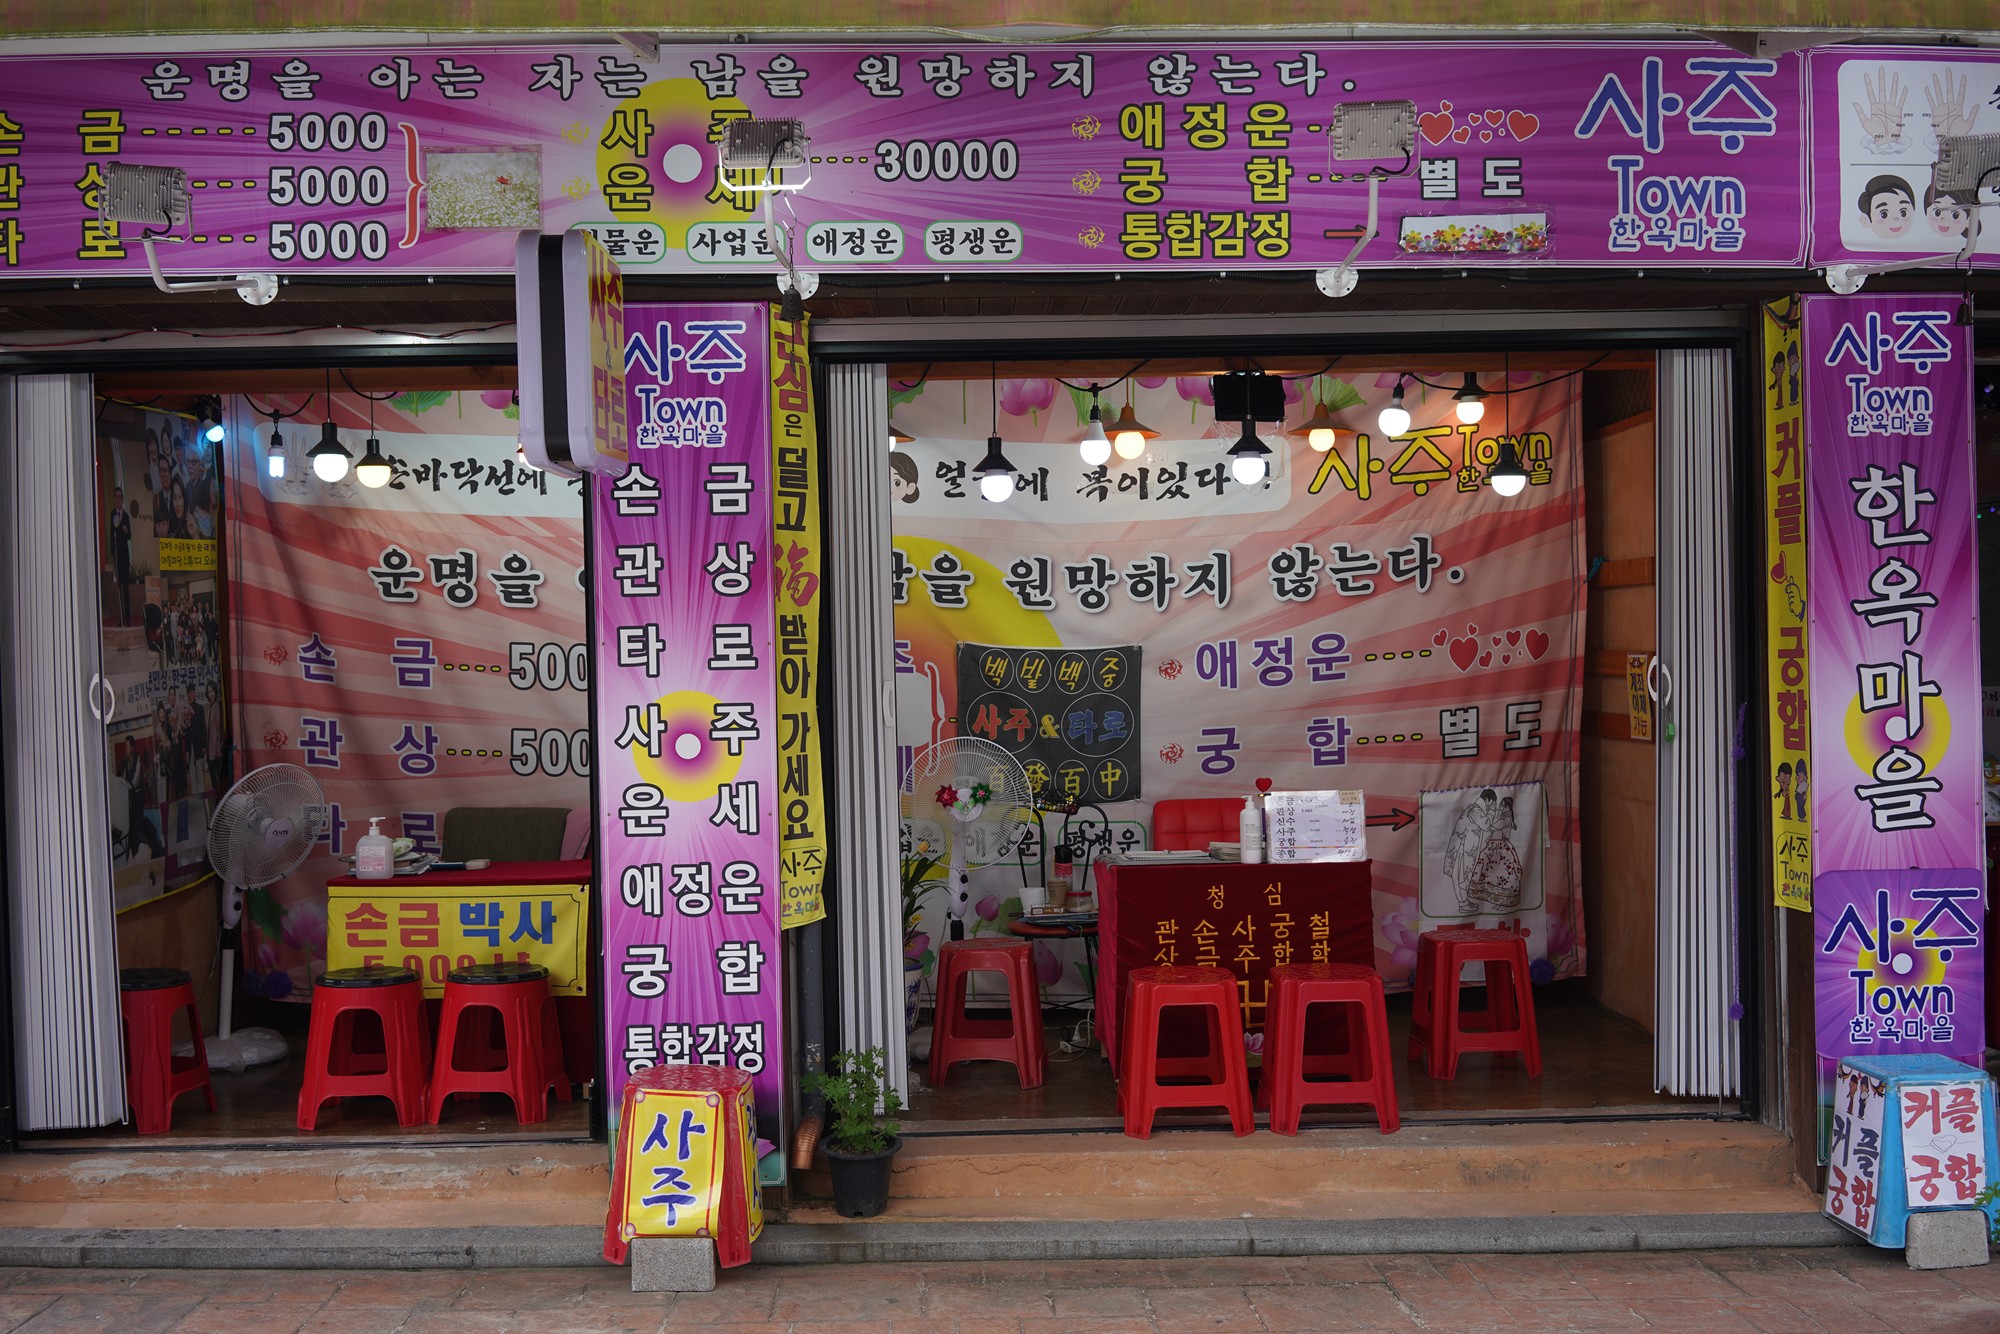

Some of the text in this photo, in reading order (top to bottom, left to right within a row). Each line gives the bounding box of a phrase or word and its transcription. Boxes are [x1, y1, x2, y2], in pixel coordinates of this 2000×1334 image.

[141, 53, 1356, 101] 운명을 아는 자는 남을 원망하지 않는다.
[267, 112, 389, 152] 5000
[1119, 102, 1294, 150] 애정운
[1574, 57, 1778, 154] 사주
[267, 166, 389, 207] 5000
[874, 139, 1020, 182] 30000
[1119, 157, 1525, 204] 궁합 별도
[1607, 154, 1746, 218] Town
[267, 220, 389, 262] 5000
[590, 228, 659, 257] 물운
[812, 228, 898, 257] 애정운
[930, 227, 1017, 255] 평생운
[1119, 210, 1292, 260] 통합감정
[1608, 215, 1746, 252] 한옥마을
[624, 320, 747, 385] 사주
[1824, 310, 1951, 375] 사주
[635, 384, 727, 425] Town
[1846, 374, 1932, 415] Town
[636, 424, 727, 449] 한옥마을
[1848, 413, 1932, 437] 한옥마을
[611, 462, 754, 517] 손금
[776, 447, 809, 532] 덜고
[936, 460, 1049, 502] 얼에
[1308, 425, 1453, 500] 사주
[1457, 460, 1552, 493] 한을
[367, 544, 545, 608] 운명을
[613, 541, 755, 597] 관상
[1002, 549, 1231, 613] 원망하지
[1268, 533, 1464, 602] 않는다.
[298, 632, 437, 689] 손금
[616, 624, 759, 678] 타로
[779, 614, 811, 699] 받아
[1196, 632, 1352, 690] 애정운
[1850, 461, 1942, 832] 한옥마을
[1777, 626, 1807, 751] 궁합
[299, 716, 439, 776] 관상
[615, 702, 760, 758] 사주
[972, 704, 1128, 745] 사주 & 타로
[1196, 701, 1542, 775] 궁합 별도
[781, 711, 814, 841] 가세요
[618, 781, 761, 837] 운세
[781, 848, 822, 878] 사주
[1779, 836, 1809, 861] 사주
[621, 860, 764, 918] 애정운
[345, 901, 557, 947] 손금 박사
[1232, 915, 1260, 974] 사주
[1270, 913, 1295, 966] 궁합
[1309, 911, 1331, 964] 철학
[1822, 888, 1979, 965] 사주
[622, 941, 765, 1000] 궁합
[1849, 969, 1955, 1016] Town
[623, 1021, 765, 1077] 통합감정
[1849, 1015, 1955, 1044] 한옥마을
[1904, 1088, 1979, 1135] 커플
[641, 1109, 706, 1227] 사주
[1832, 1114, 1880, 1179] 커플
[1828, 1164, 1876, 1229] 궁합
[1909, 1153, 1983, 1202] 궁합
